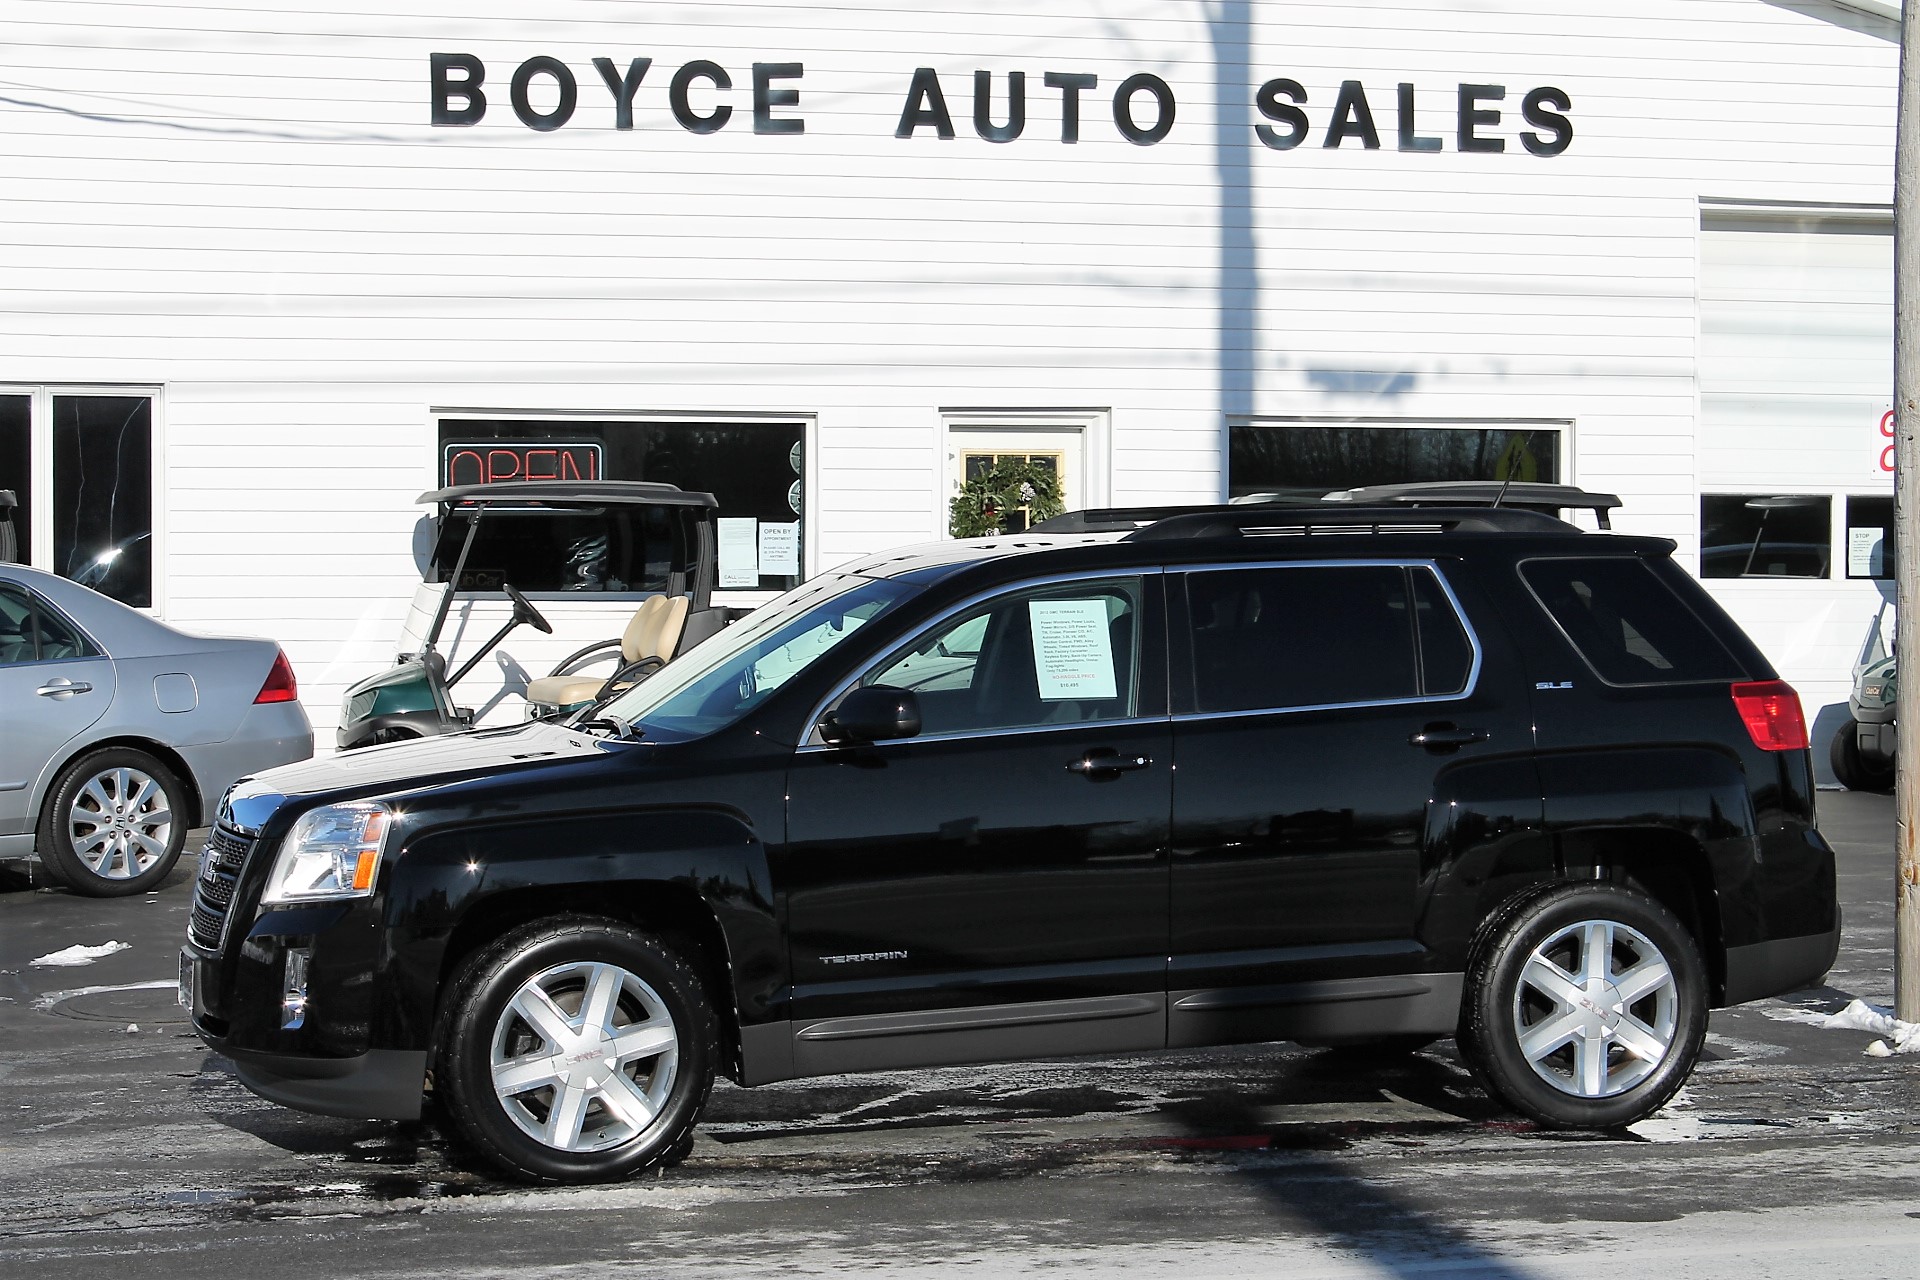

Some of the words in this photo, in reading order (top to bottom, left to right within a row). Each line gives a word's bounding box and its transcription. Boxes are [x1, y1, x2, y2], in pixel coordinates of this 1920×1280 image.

[430, 52, 804, 134] BOYCE
[894, 67, 1177, 145] AUTO
[1255, 78, 1574, 157] SALES
[450, 449, 597, 504] OPEN
[476, 573, 500, 586] Car
[1535, 680, 1574, 690] SLE
[818, 950, 908, 964] TERRAIN
